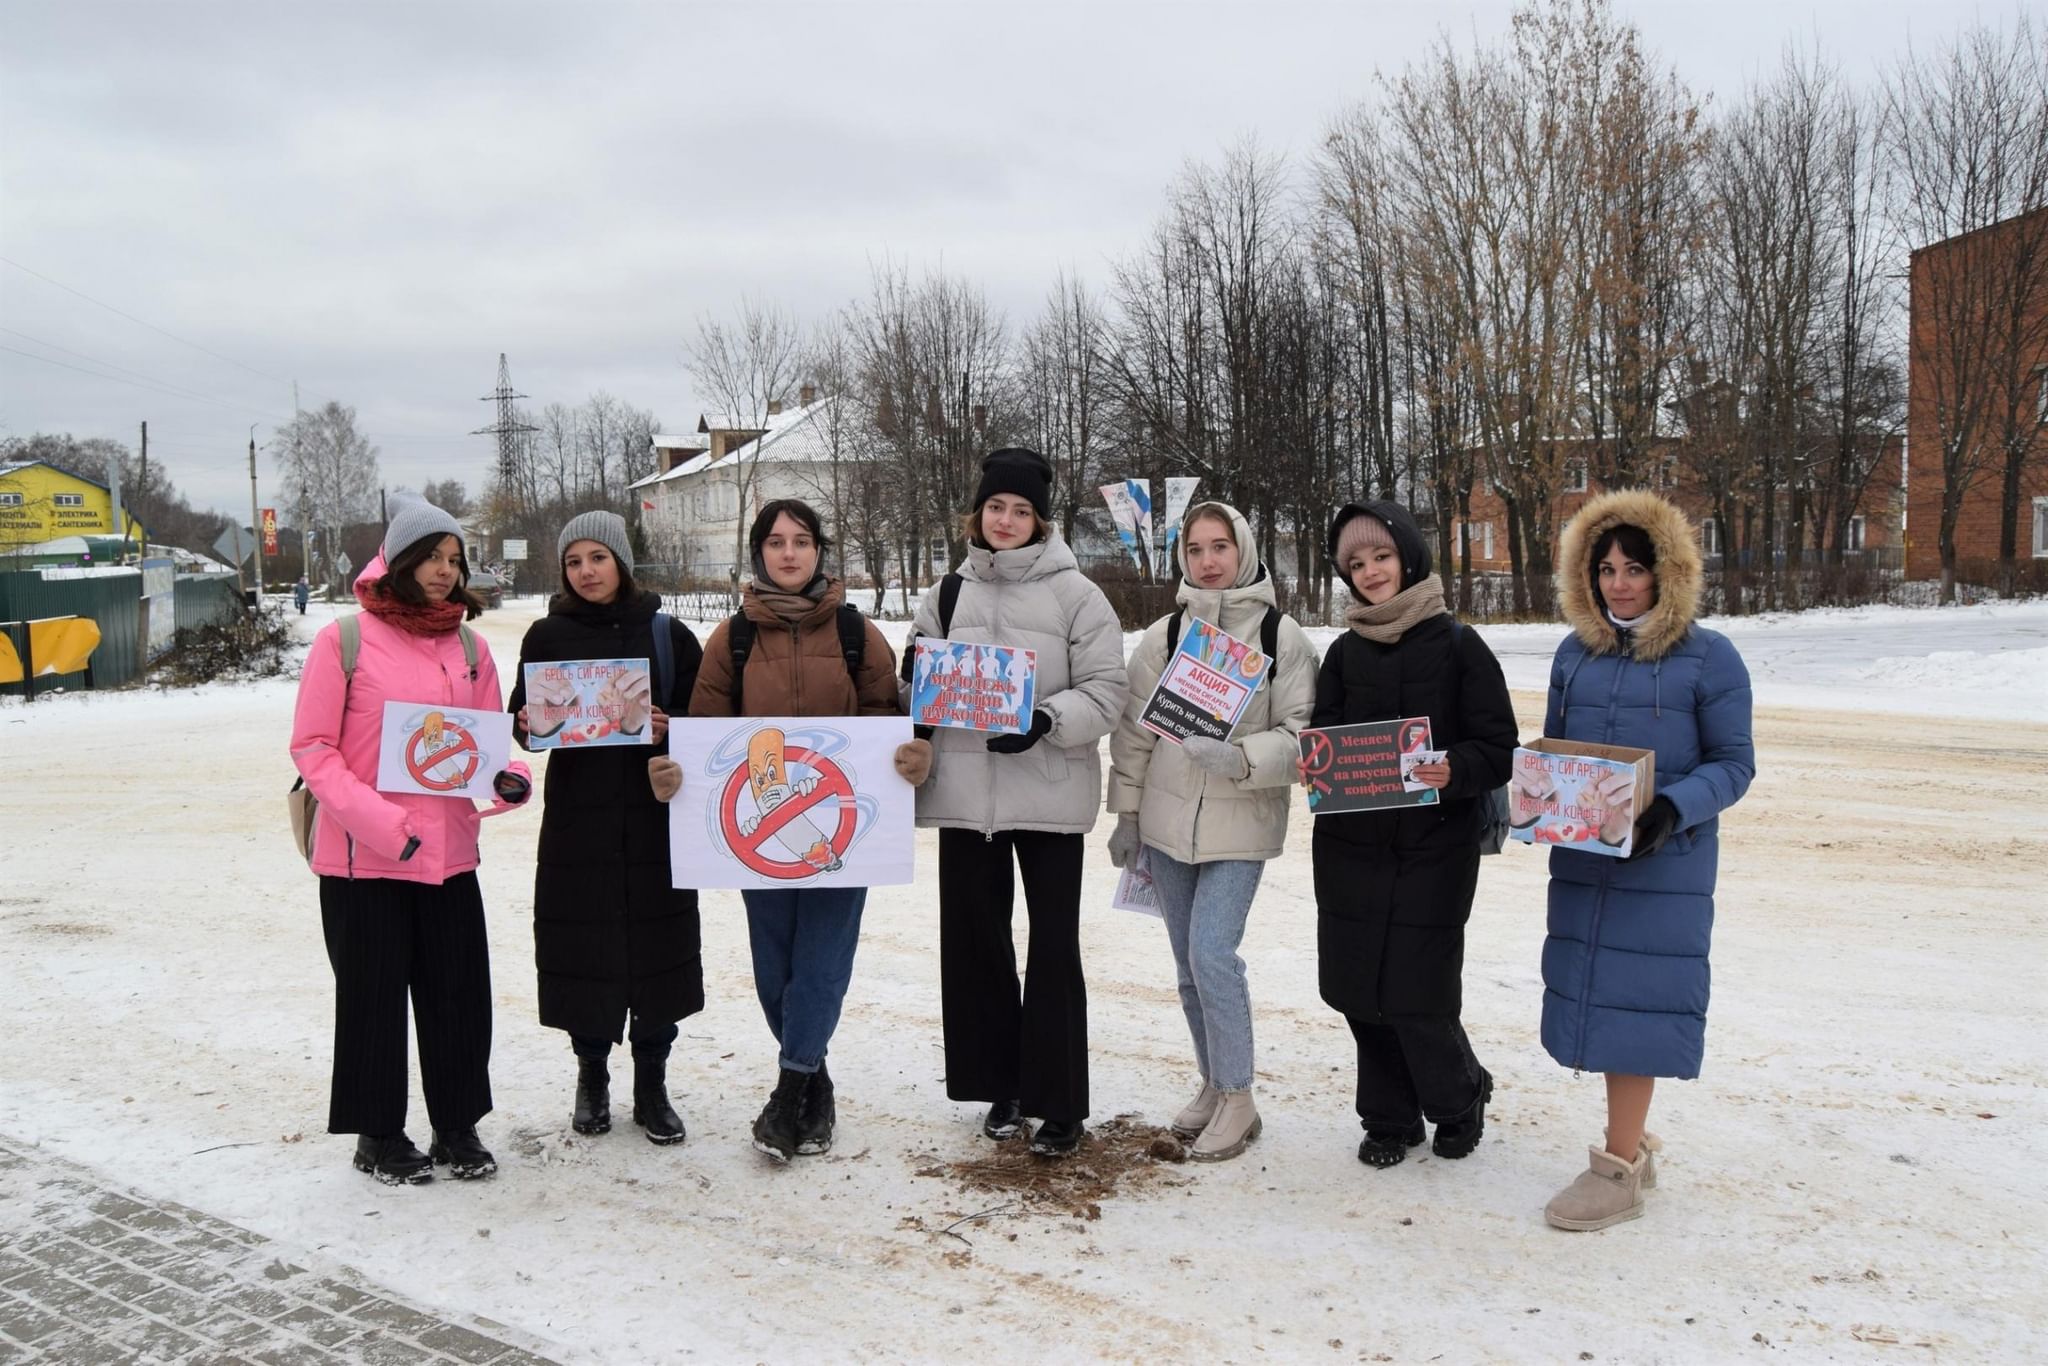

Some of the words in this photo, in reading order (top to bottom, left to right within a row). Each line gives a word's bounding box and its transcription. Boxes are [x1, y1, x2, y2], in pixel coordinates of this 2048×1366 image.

[545, 667, 574, 681] БРОСЬ
[1187, 667, 1230, 696] АКЦИЯ
[941, 690, 1004, 709] ПРОТИВ
[1178, 686, 1188, 696] НА
[1201, 690, 1232, 710] СИГАРЕТЫ
[921, 704, 1020, 728] НАРКОТИКОВ
[1156, 693, 1184, 716] Курить
[1184, 711, 1196, 722] не
[1149, 710, 1175, 729] дыши
[1174, 724, 1198, 737] своб
[1340, 734, 1393, 748] Меняем
[1337, 751, 1397, 766] сигареты
[1524, 755, 1554, 773] БРОСЬ
[1333, 771, 1349, 781] на
[1352, 767, 1400, 781] вкусны
[1344, 782, 1402, 797] конфеты
